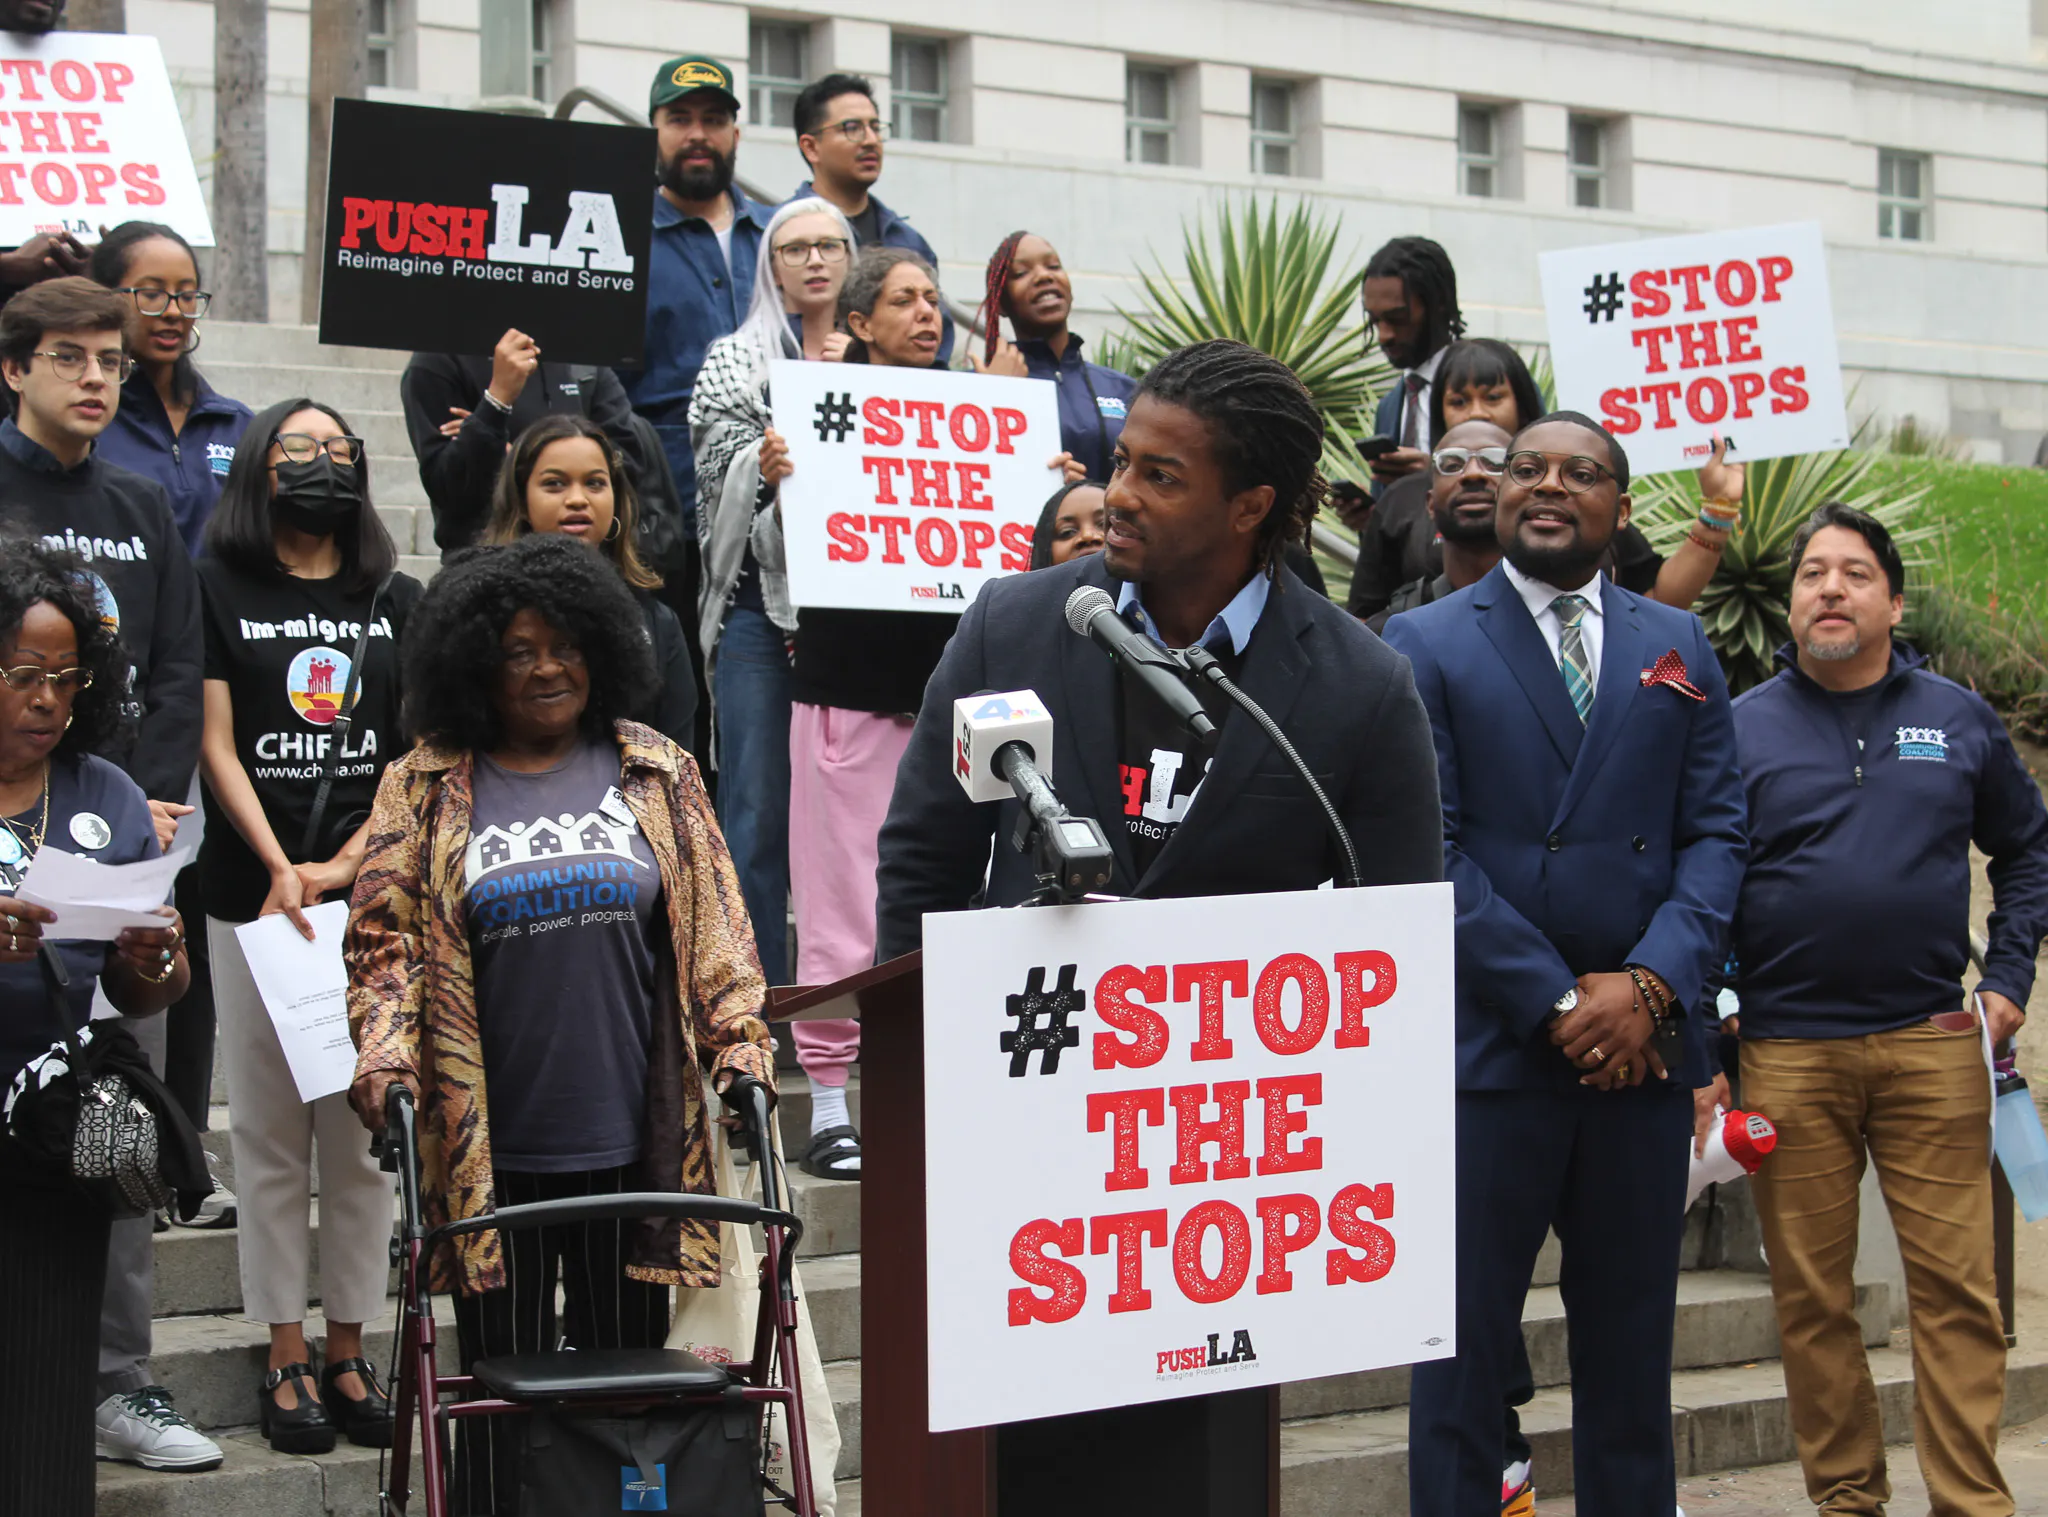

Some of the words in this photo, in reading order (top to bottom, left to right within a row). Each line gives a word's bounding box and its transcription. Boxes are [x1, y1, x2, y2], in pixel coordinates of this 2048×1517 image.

[0, 59, 134, 103] TOP
[338, 249, 444, 276] Reimagine
[453, 259, 524, 283] Protect
[532, 270, 568, 286] and
[577, 270, 634, 291] Serve
[1584, 256, 1793, 323] #STOP
[1632, 316, 1762, 373] THE
[813, 392, 1027, 455] #STOP
[1600, 366, 1809, 434] STOPS
[863, 456, 994, 511] THE
[827, 512, 1035, 572] STOPS
[1899, 749, 1944, 757] COALITION
[472, 862, 635, 905] COMMUNITY
[478, 882, 638, 927] COALITION
[529, 916, 574, 935] power.
[1000, 950, 1397, 1077] #STOP
[1087, 1073, 1323, 1192] THE
[1008, 1183, 1395, 1326] STOPS
[1156, 1372, 1194, 1381] Reimagine
[1196, 1366, 1221, 1376] Protect
[1224, 1363, 1237, 1372] and
[1240, 1361, 1260, 1370] Serve
